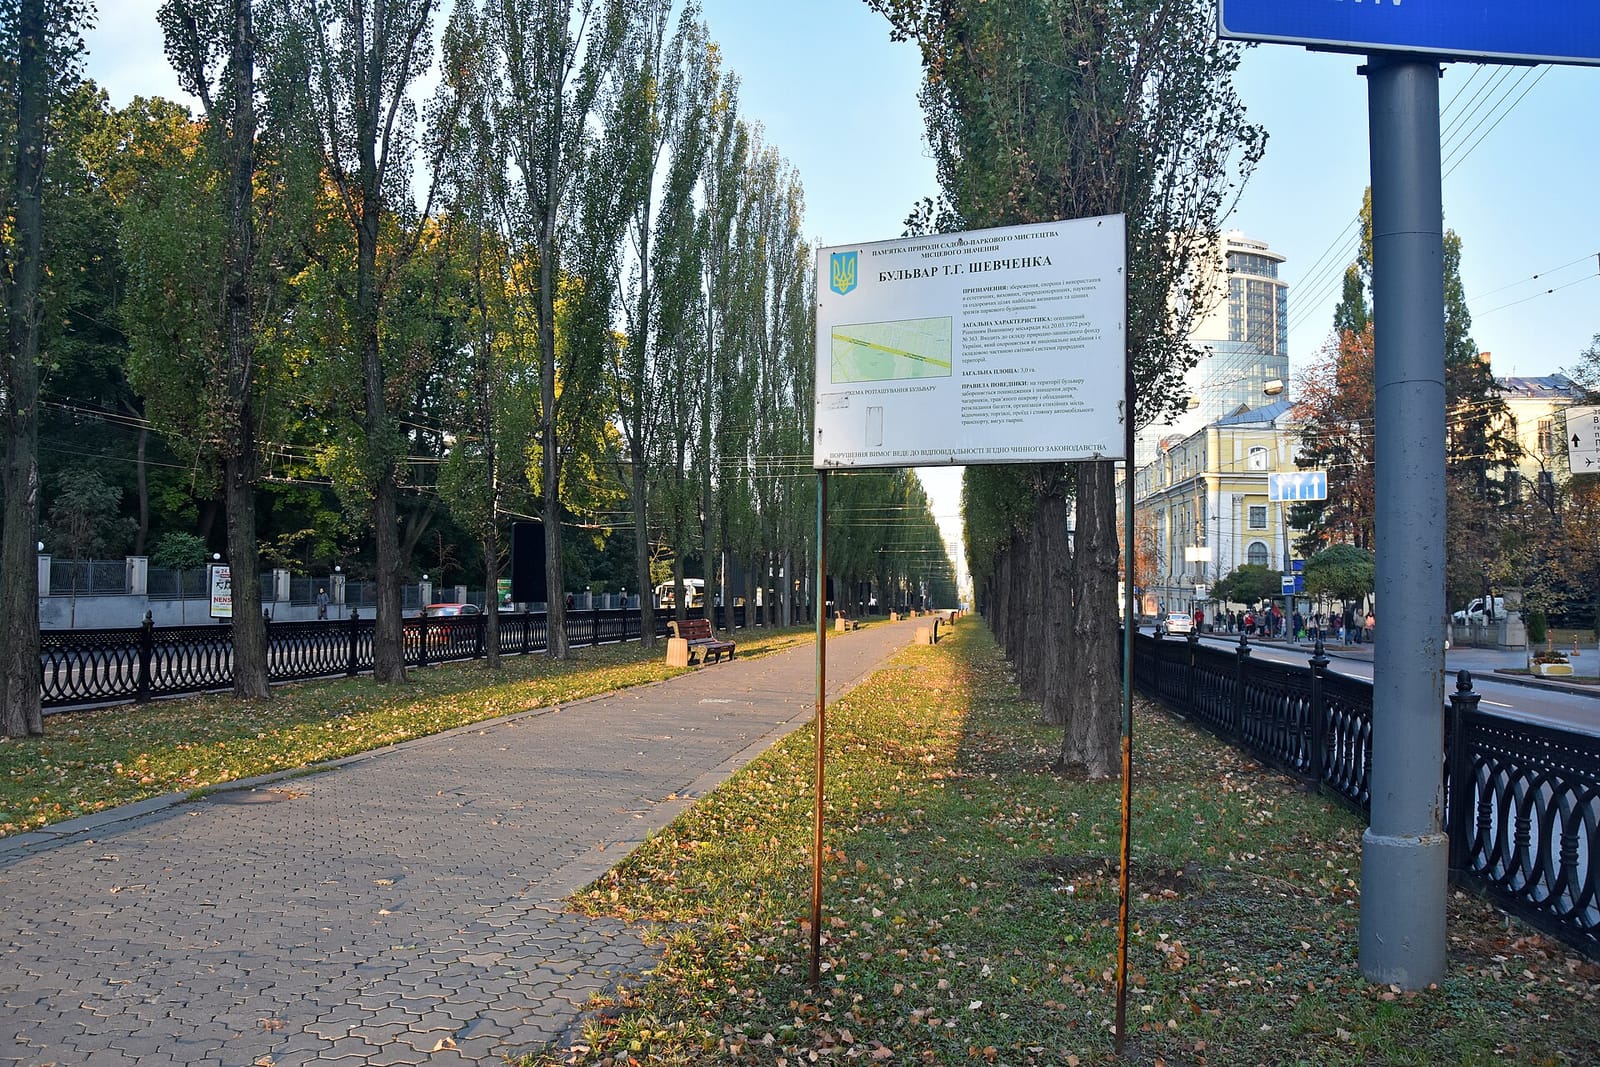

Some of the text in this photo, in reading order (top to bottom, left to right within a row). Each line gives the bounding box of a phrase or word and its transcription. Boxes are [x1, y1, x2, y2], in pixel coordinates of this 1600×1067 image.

[907, 243, 940, 253] ПРИРОДИ
[940, 234, 1012, 249] САДОВО-ПАРКОВОГО
[1014, 231, 1059, 241] МИСТЕЦТВА
[921, 245, 1000, 259] МІСЦЕВОГО ЗНАЧЕННЯ
[879, 255, 1052, 282] БУЛЬВАР Т.Г. ШЕВЧЕНКА
[962, 285, 1008, 294] ПРИЗНАЧЕННЯ:
[994, 317, 1052, 326] ХАРАКТЕРИСТИКА:
[921, 448, 984, 456] ВІДПОВІДАЛЬНОСТІ
